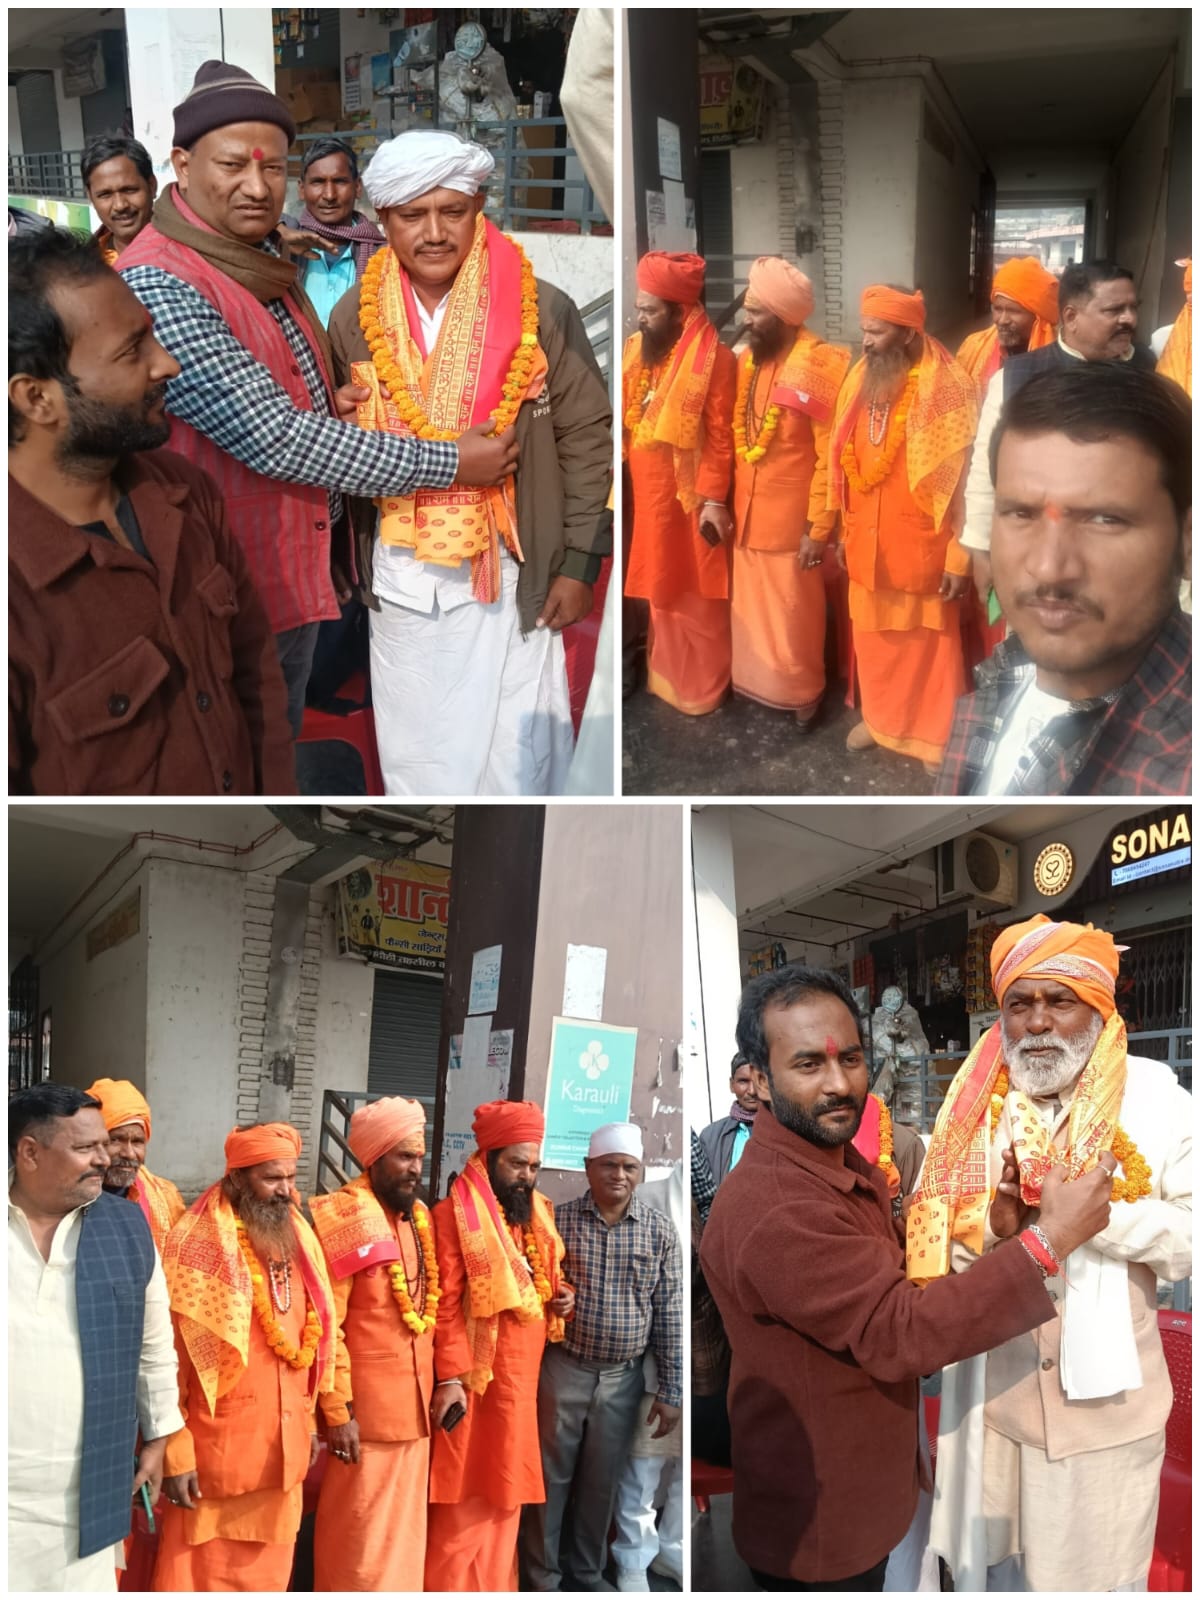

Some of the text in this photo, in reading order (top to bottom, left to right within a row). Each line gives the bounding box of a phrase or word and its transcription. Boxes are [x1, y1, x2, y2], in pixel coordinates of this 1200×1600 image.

[432, 495, 449, 505] राम
[1111, 813, 1191, 864] SONA
[561, 1080, 621, 1105] Karauli
